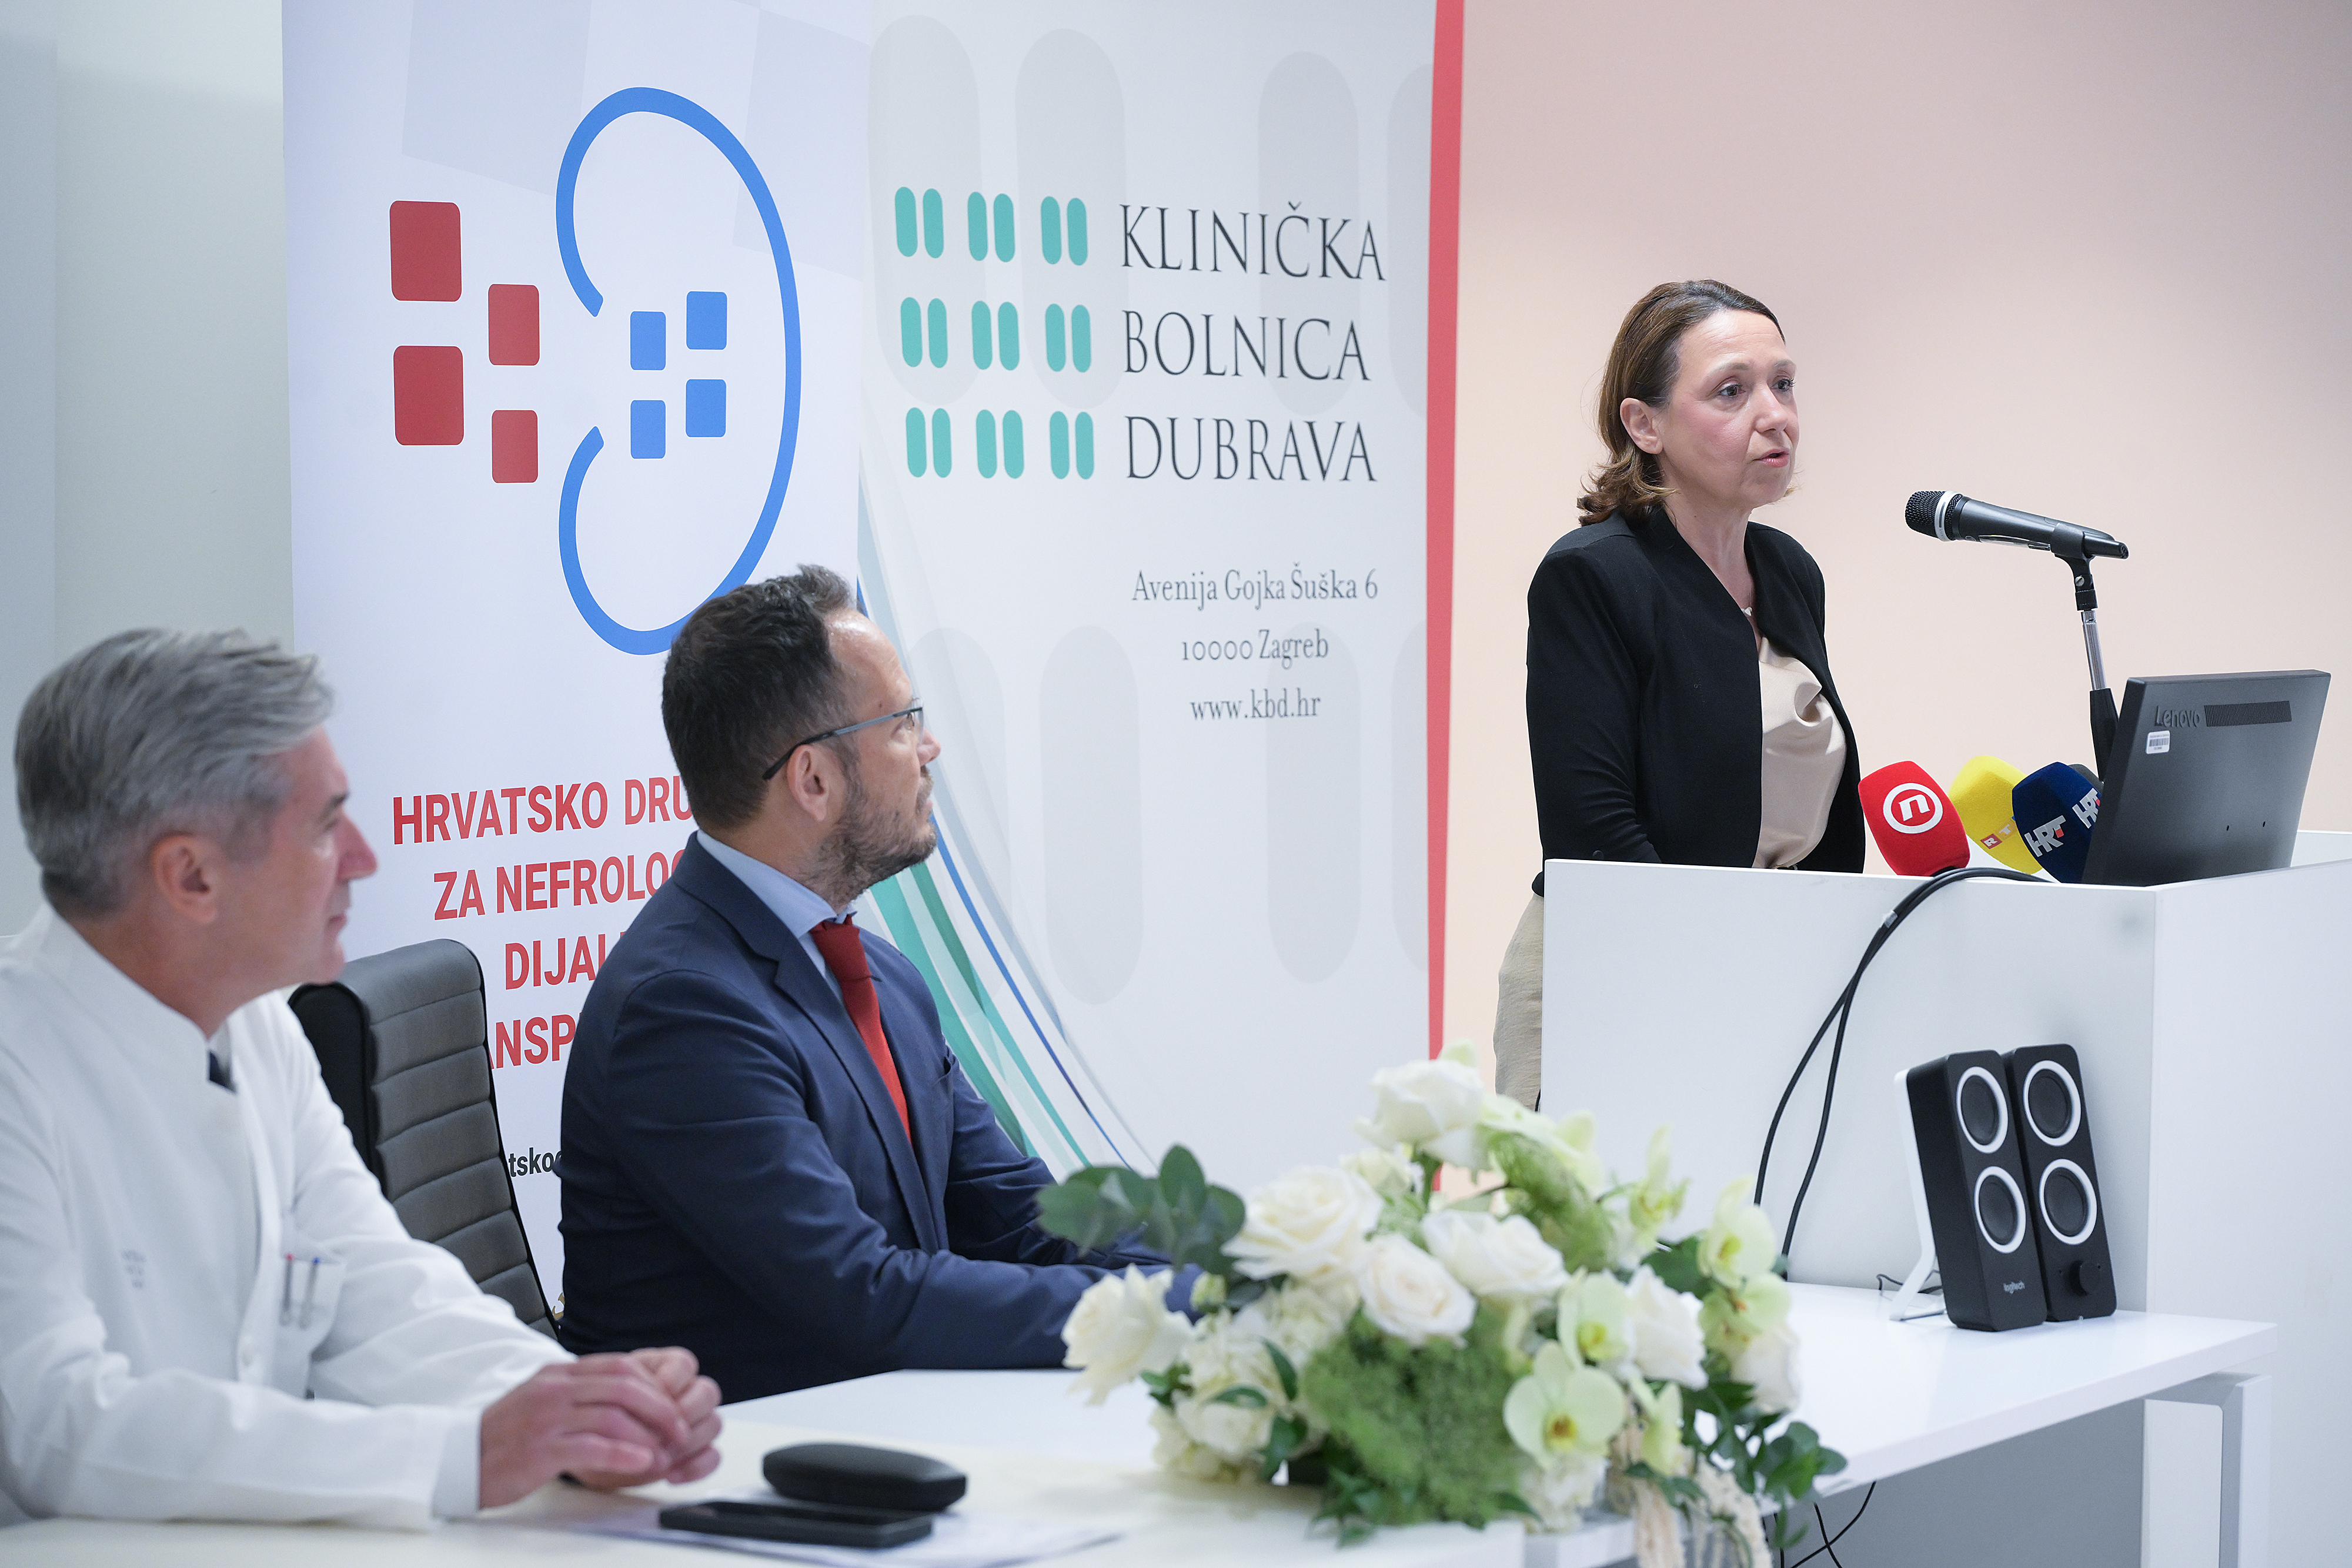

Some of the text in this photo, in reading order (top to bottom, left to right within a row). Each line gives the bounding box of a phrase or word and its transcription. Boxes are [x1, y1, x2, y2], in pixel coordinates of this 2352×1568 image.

[1120, 201, 1386, 281] KLINIČKA
[1122, 310, 1371, 380] BOLNICA
[1125, 416, 1377, 482] DUBRAVA
[1132, 561, 1378, 611] Avenija Gojka Šuška 6
[1182, 628, 1329, 670] 10000 Zagreb
[1190, 687, 1321, 720] www.kbd.hr
[2154, 706, 2200, 727] Lenovo
[393, 775, 693, 845] HRVATSKO DRU
[2024, 815, 2066, 857] HRT
[434, 870, 485, 920] ZA
[505, 931, 625, 990] DIJAL
[489, 1012, 581, 1070] NSP
